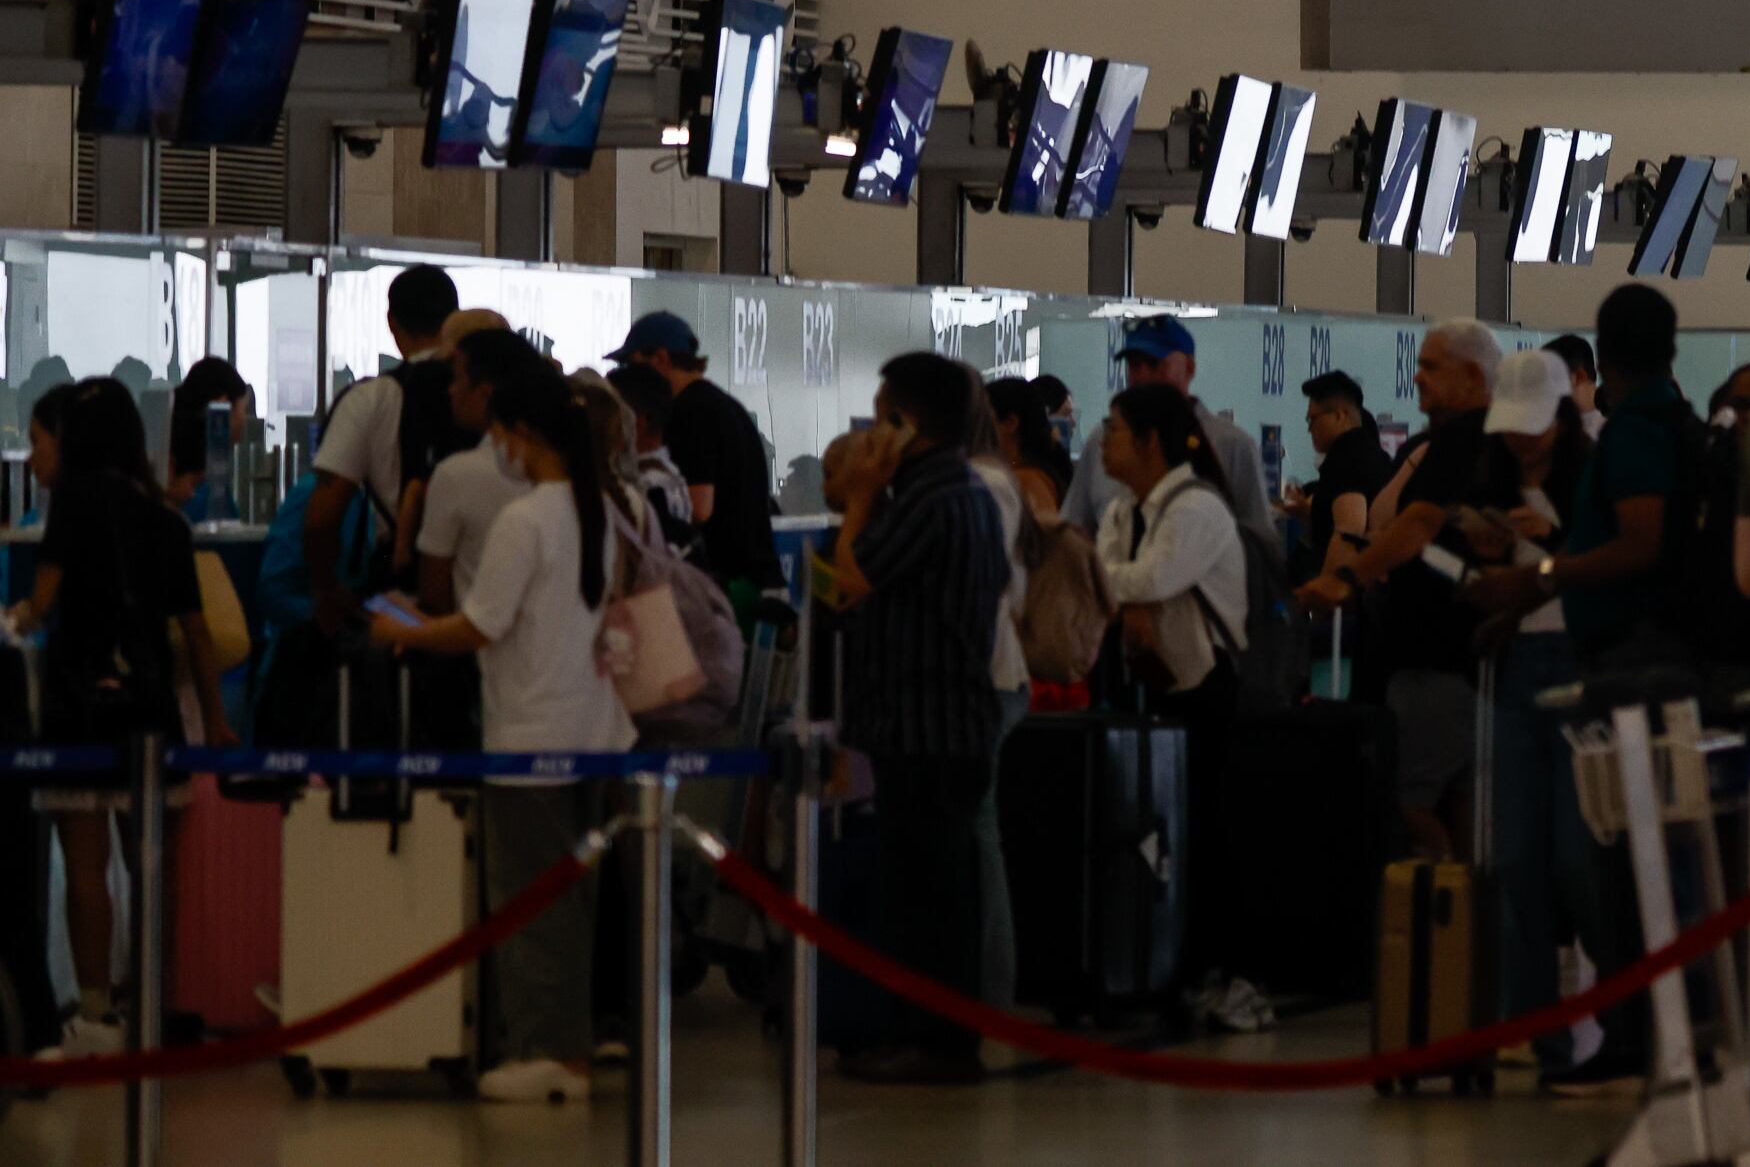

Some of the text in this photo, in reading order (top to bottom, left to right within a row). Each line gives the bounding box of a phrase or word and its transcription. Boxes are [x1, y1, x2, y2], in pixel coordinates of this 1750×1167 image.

[734, 296, 767, 385] B22
[803, 299, 834, 386] B23
[994, 294, 1024, 380] B25
[1261, 323, 1286, 397] B28
[1395, 330, 1417, 400] B30
